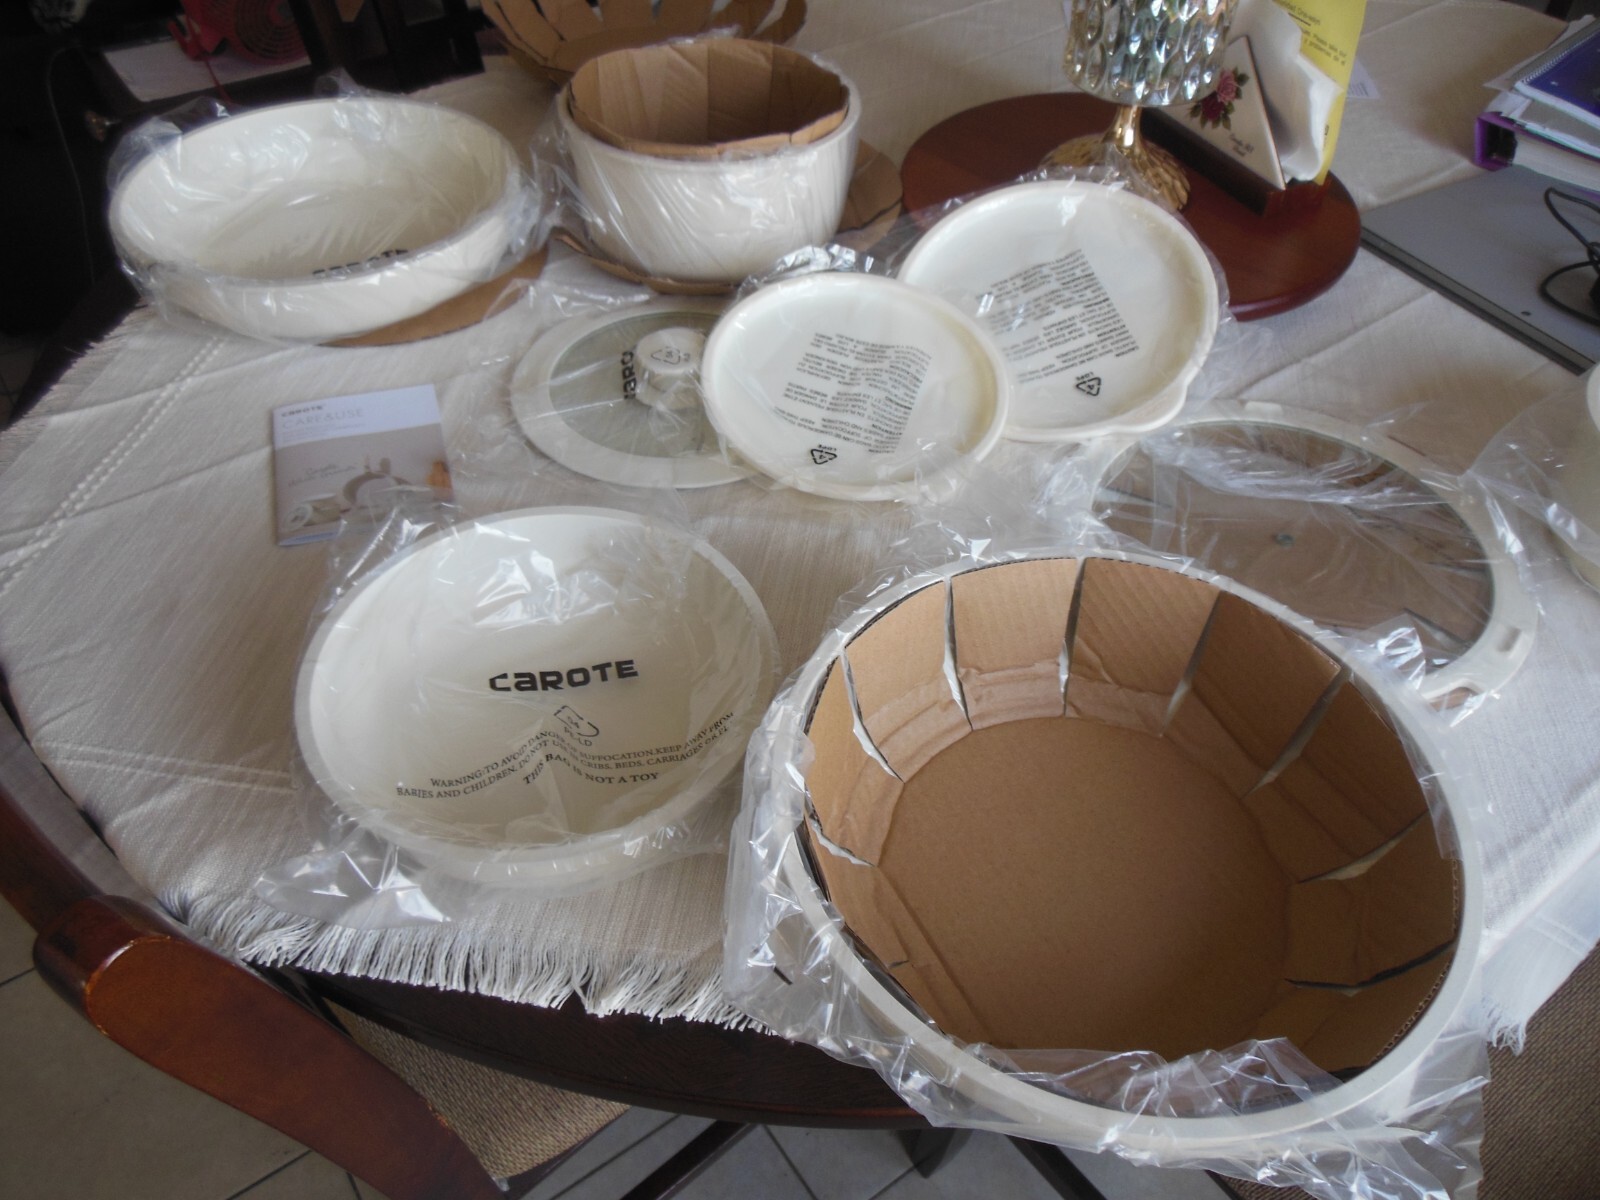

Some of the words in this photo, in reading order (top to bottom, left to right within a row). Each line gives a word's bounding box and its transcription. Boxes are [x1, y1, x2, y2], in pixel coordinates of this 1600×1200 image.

[585, 772, 616, 784] NOT
[617, 775, 629, 784] A
[629, 772, 660, 783] TOY
[396, 787, 434, 799] BABIES
[436, 789, 461, 799] AND
